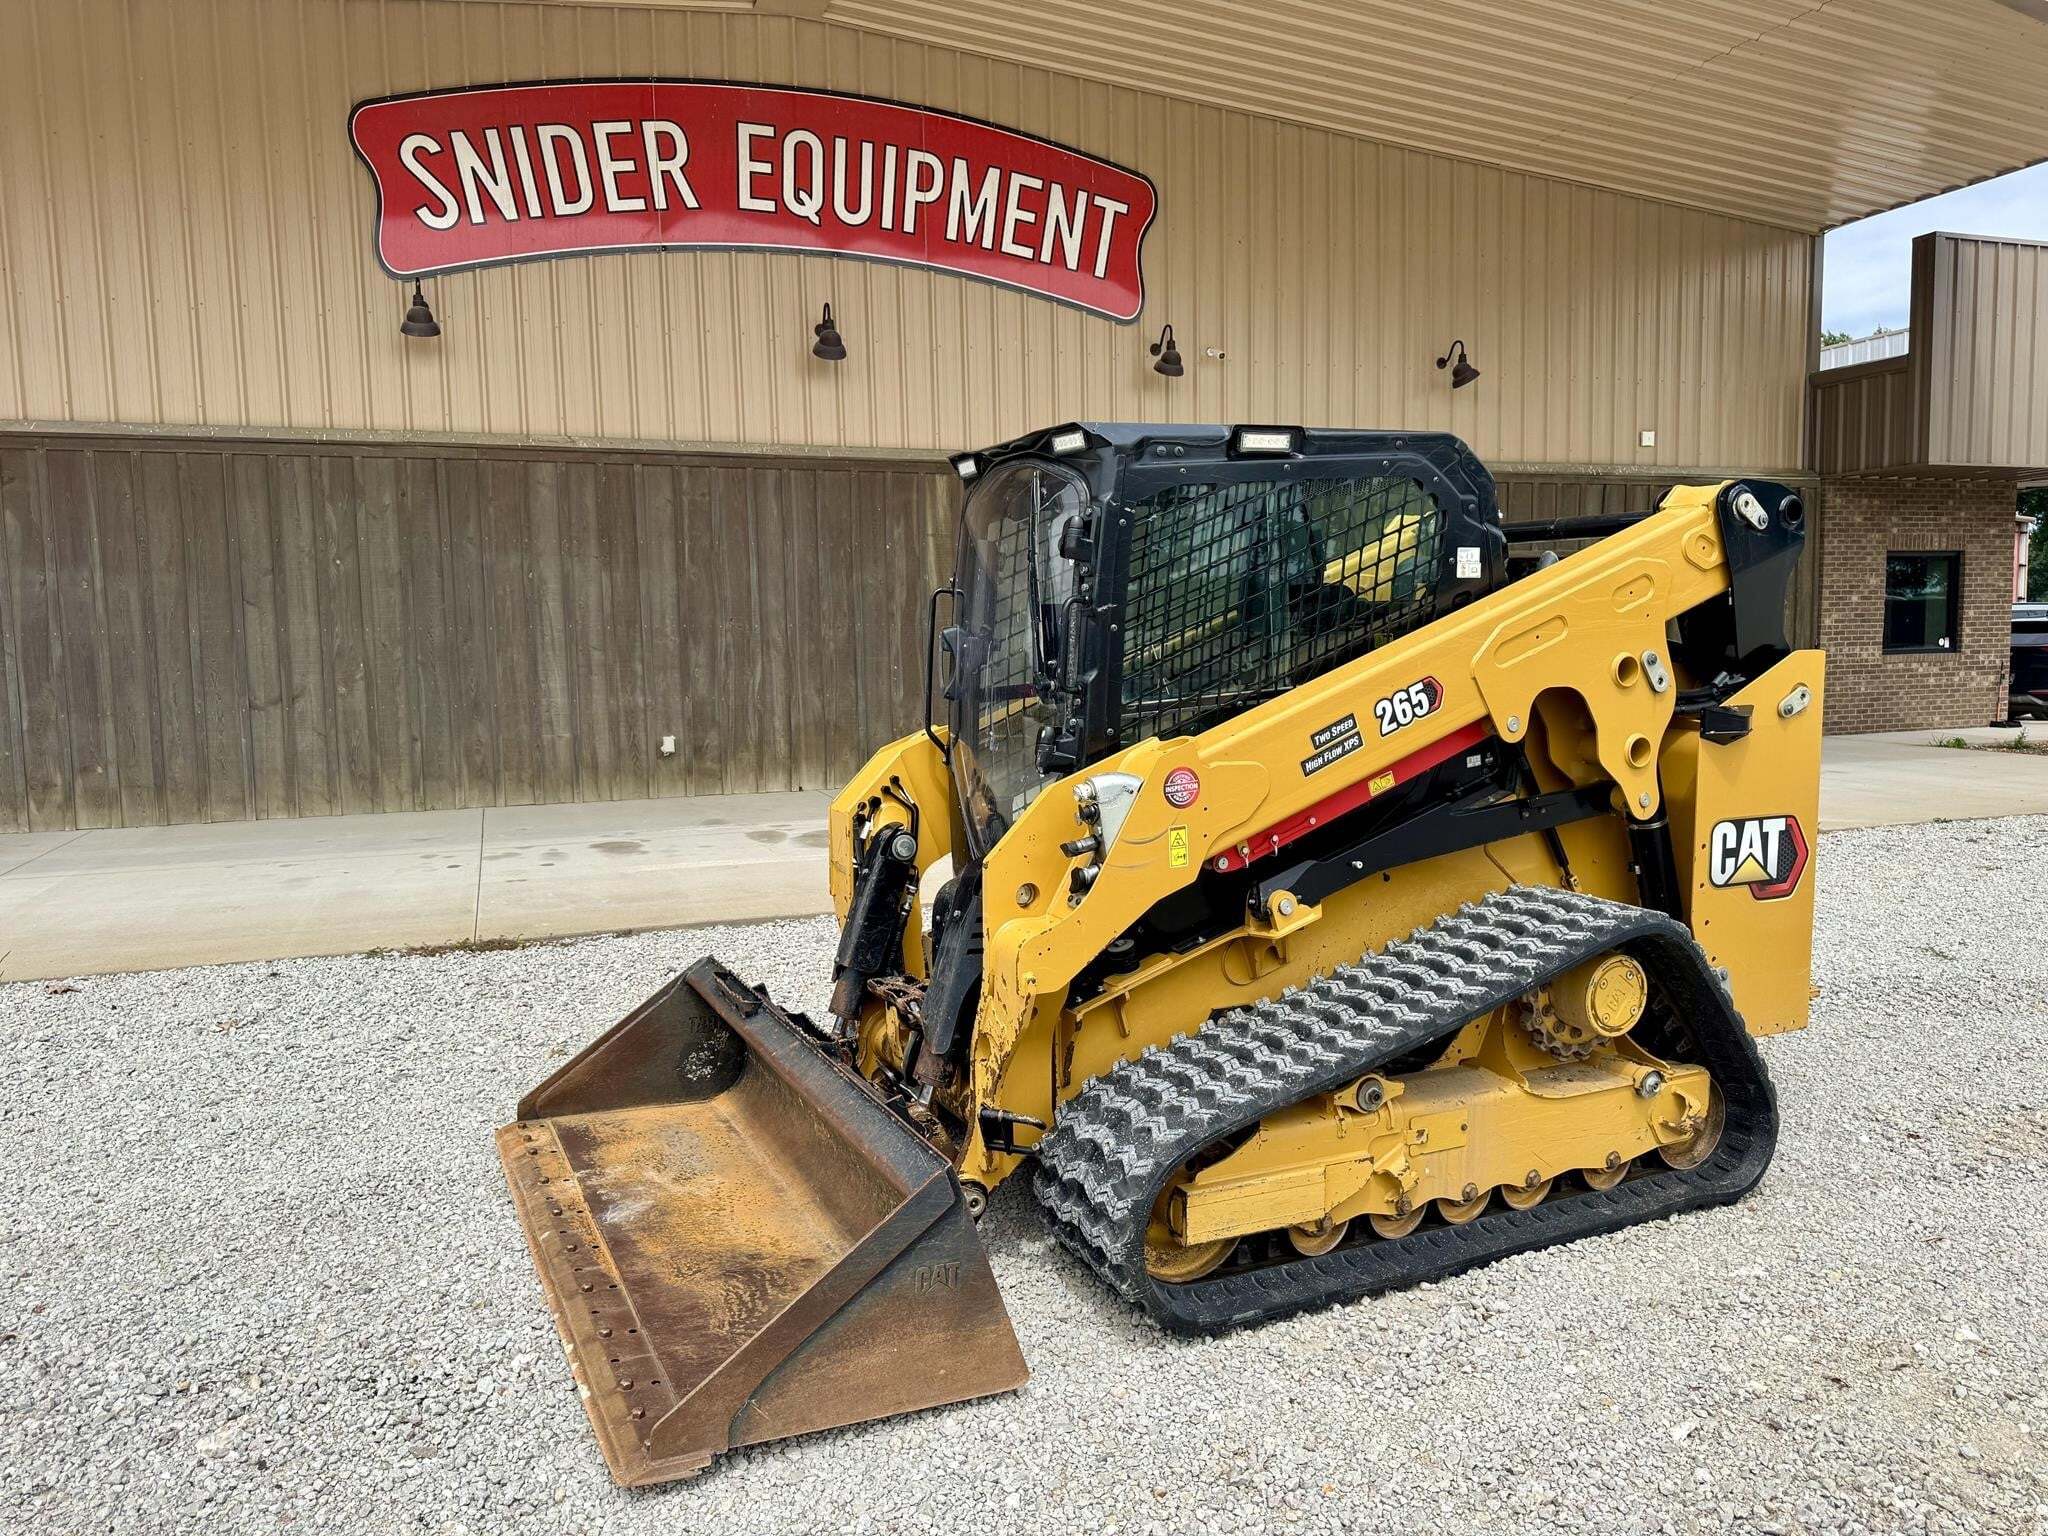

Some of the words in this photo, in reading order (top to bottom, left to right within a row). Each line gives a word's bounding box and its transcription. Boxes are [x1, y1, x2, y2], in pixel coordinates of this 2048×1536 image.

[398, 120, 701, 231] SNIDER
[735, 121, 1129, 280] EQUIPMENT
[1375, 681, 1430, 735] 265
[1314, 730, 1331, 746] TWO
[1331, 718, 1354, 737] SPEED
[1305, 756, 1323, 773] HIGH
[1323, 745, 1343, 763] FLOW
[1343, 735, 1359, 752] XPS
[1165, 782, 1198, 793] INSPECTION
[1711, 817, 1787, 886] CAT
[915, 1261, 961, 1296] CAT
